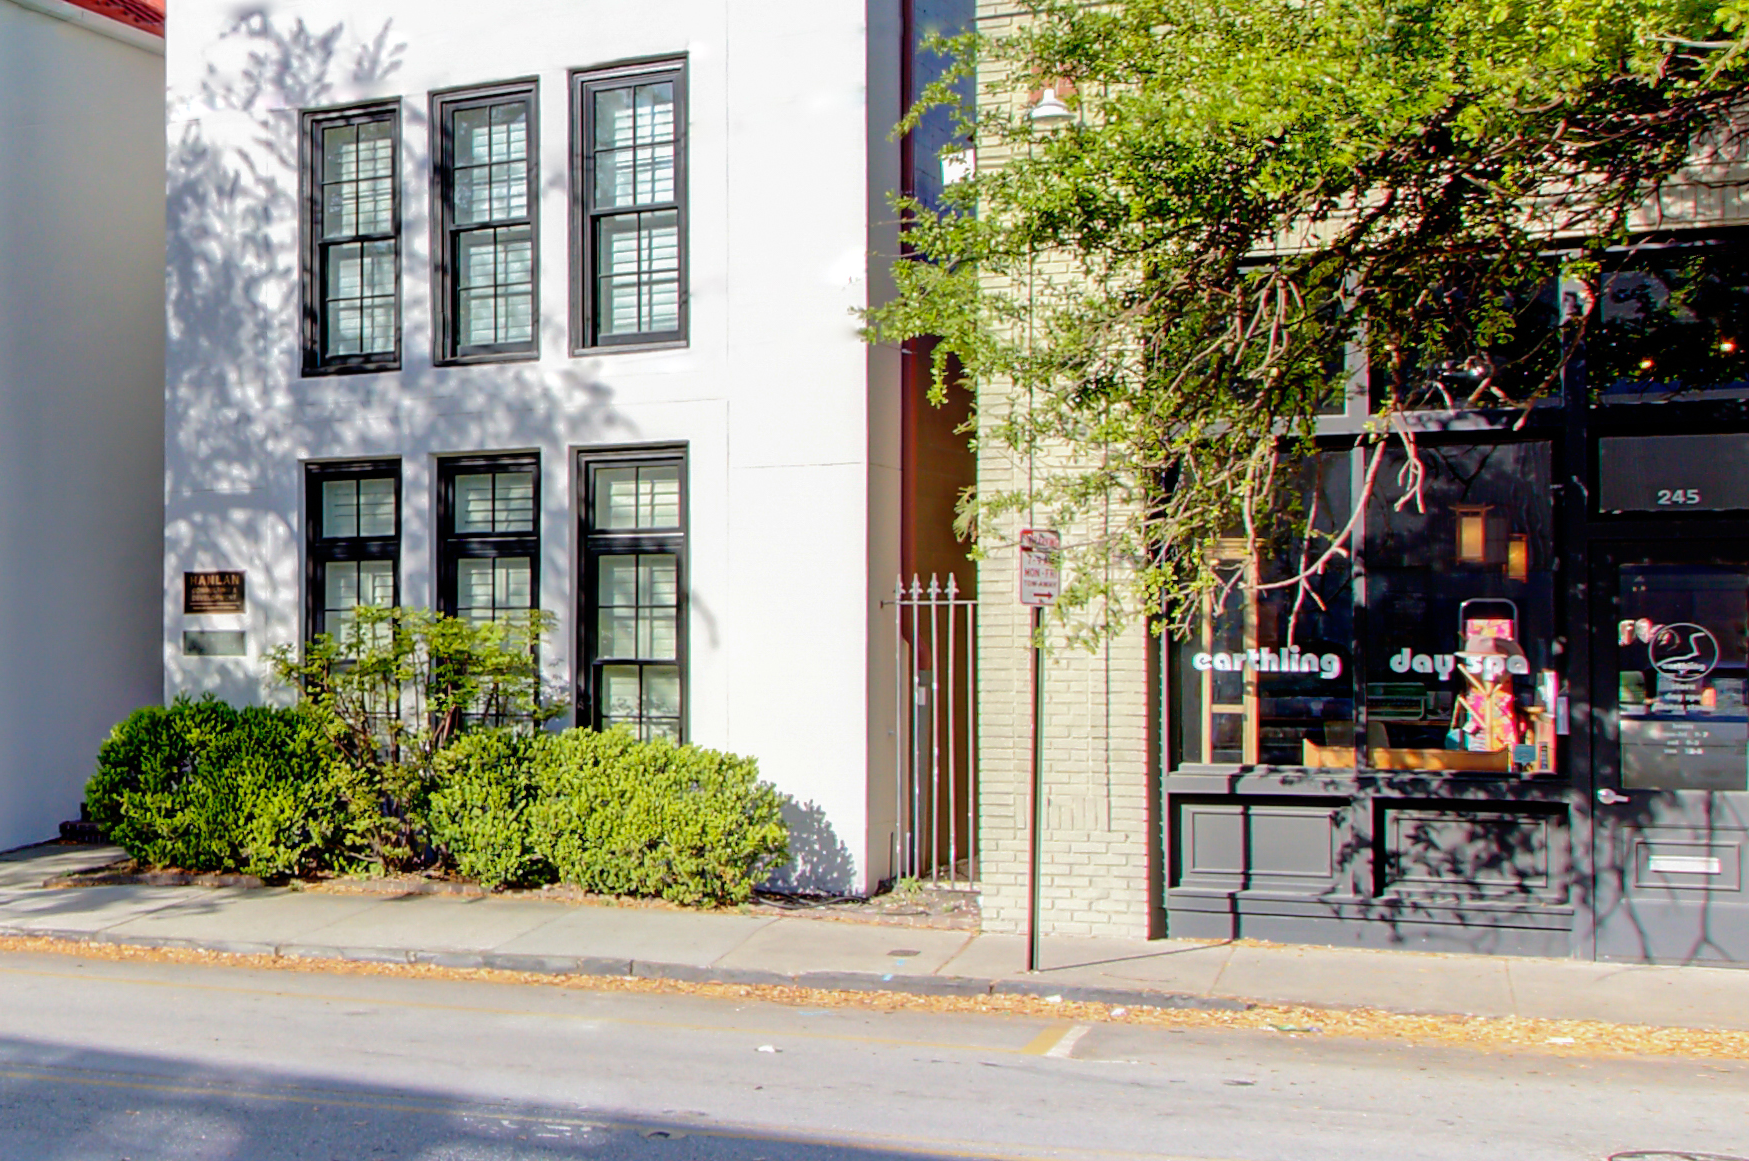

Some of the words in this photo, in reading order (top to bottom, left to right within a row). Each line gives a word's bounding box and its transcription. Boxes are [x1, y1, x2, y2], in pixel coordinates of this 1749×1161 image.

[1657, 489, 1701, 505] 245
[190, 574, 240, 586] HANLAN
[1192, 645, 1343, 680] earthling
[1390, 647, 1455, 681] day
[1464, 653, 1531, 681] spa
